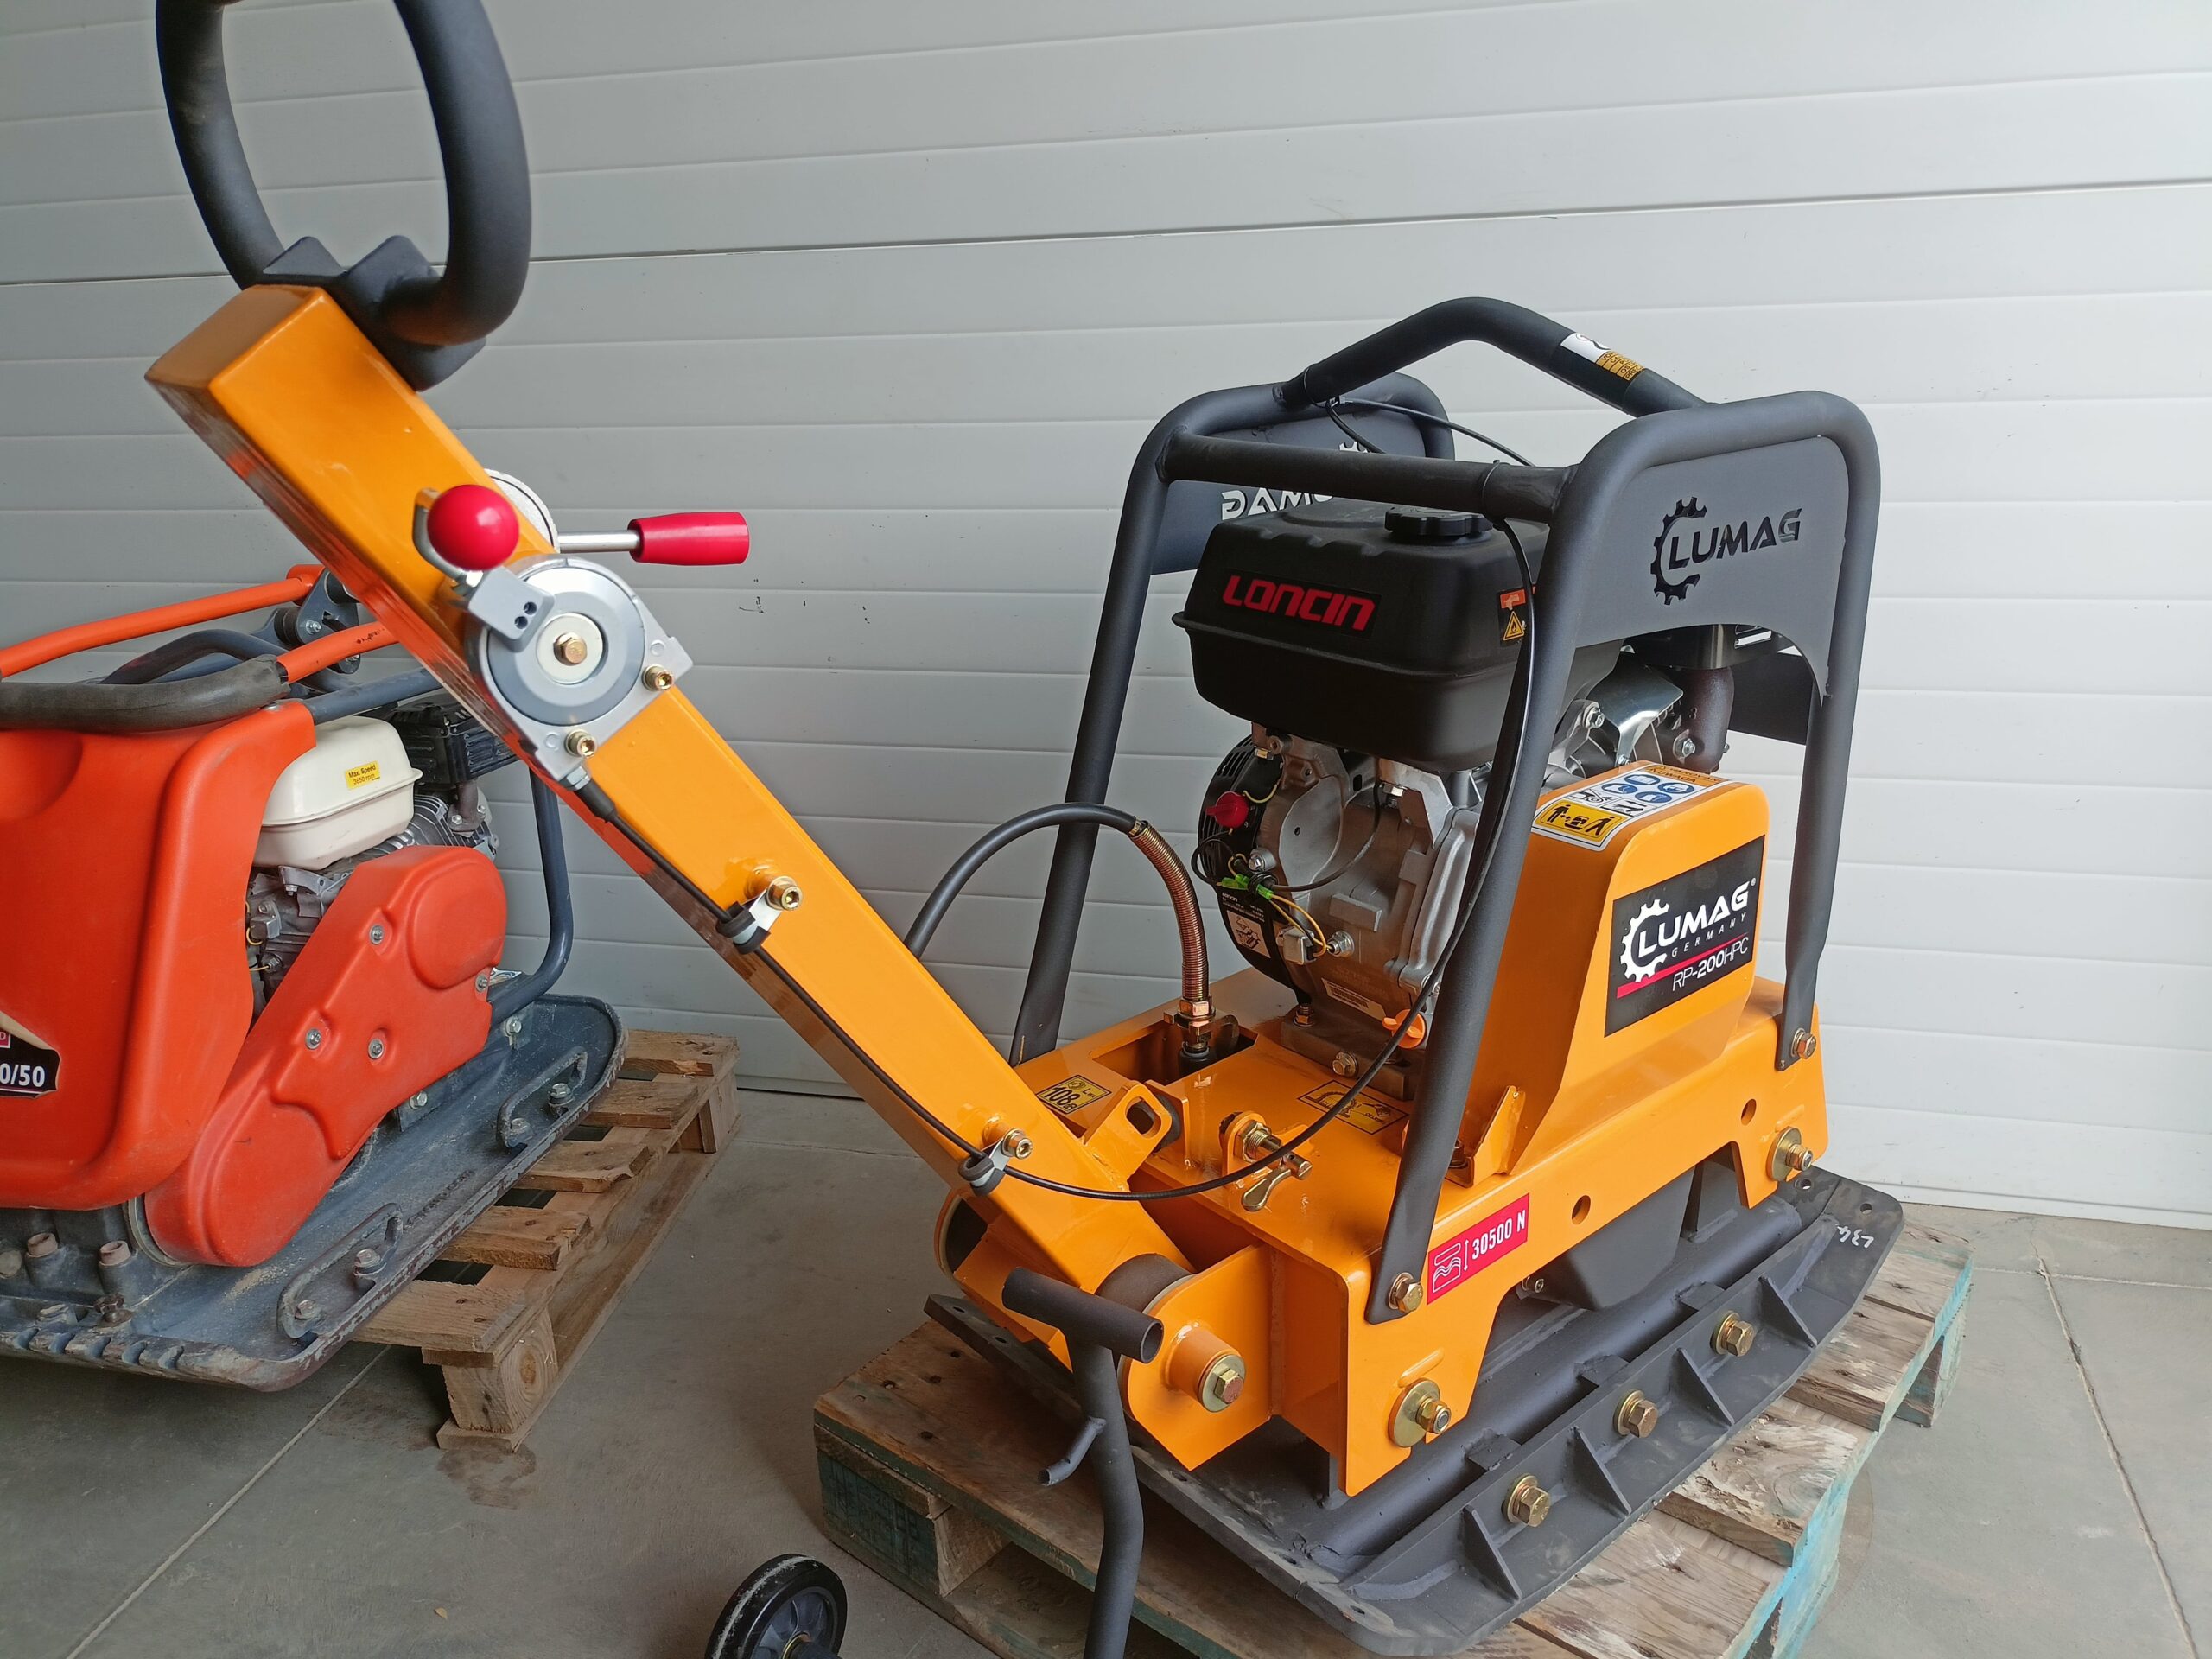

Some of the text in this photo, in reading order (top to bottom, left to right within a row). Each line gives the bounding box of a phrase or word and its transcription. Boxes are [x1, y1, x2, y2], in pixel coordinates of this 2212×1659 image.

[1669, 508, 1802, 570] LUMAG
[360, 765, 377, 774] Speed
[1638, 880, 1751, 958] LUMAG
[1671, 912, 1747, 957] GERMANY
[1672, 937, 1750, 992] RP-200HPC
[1471, 1209, 1526, 1260] 30500 N
